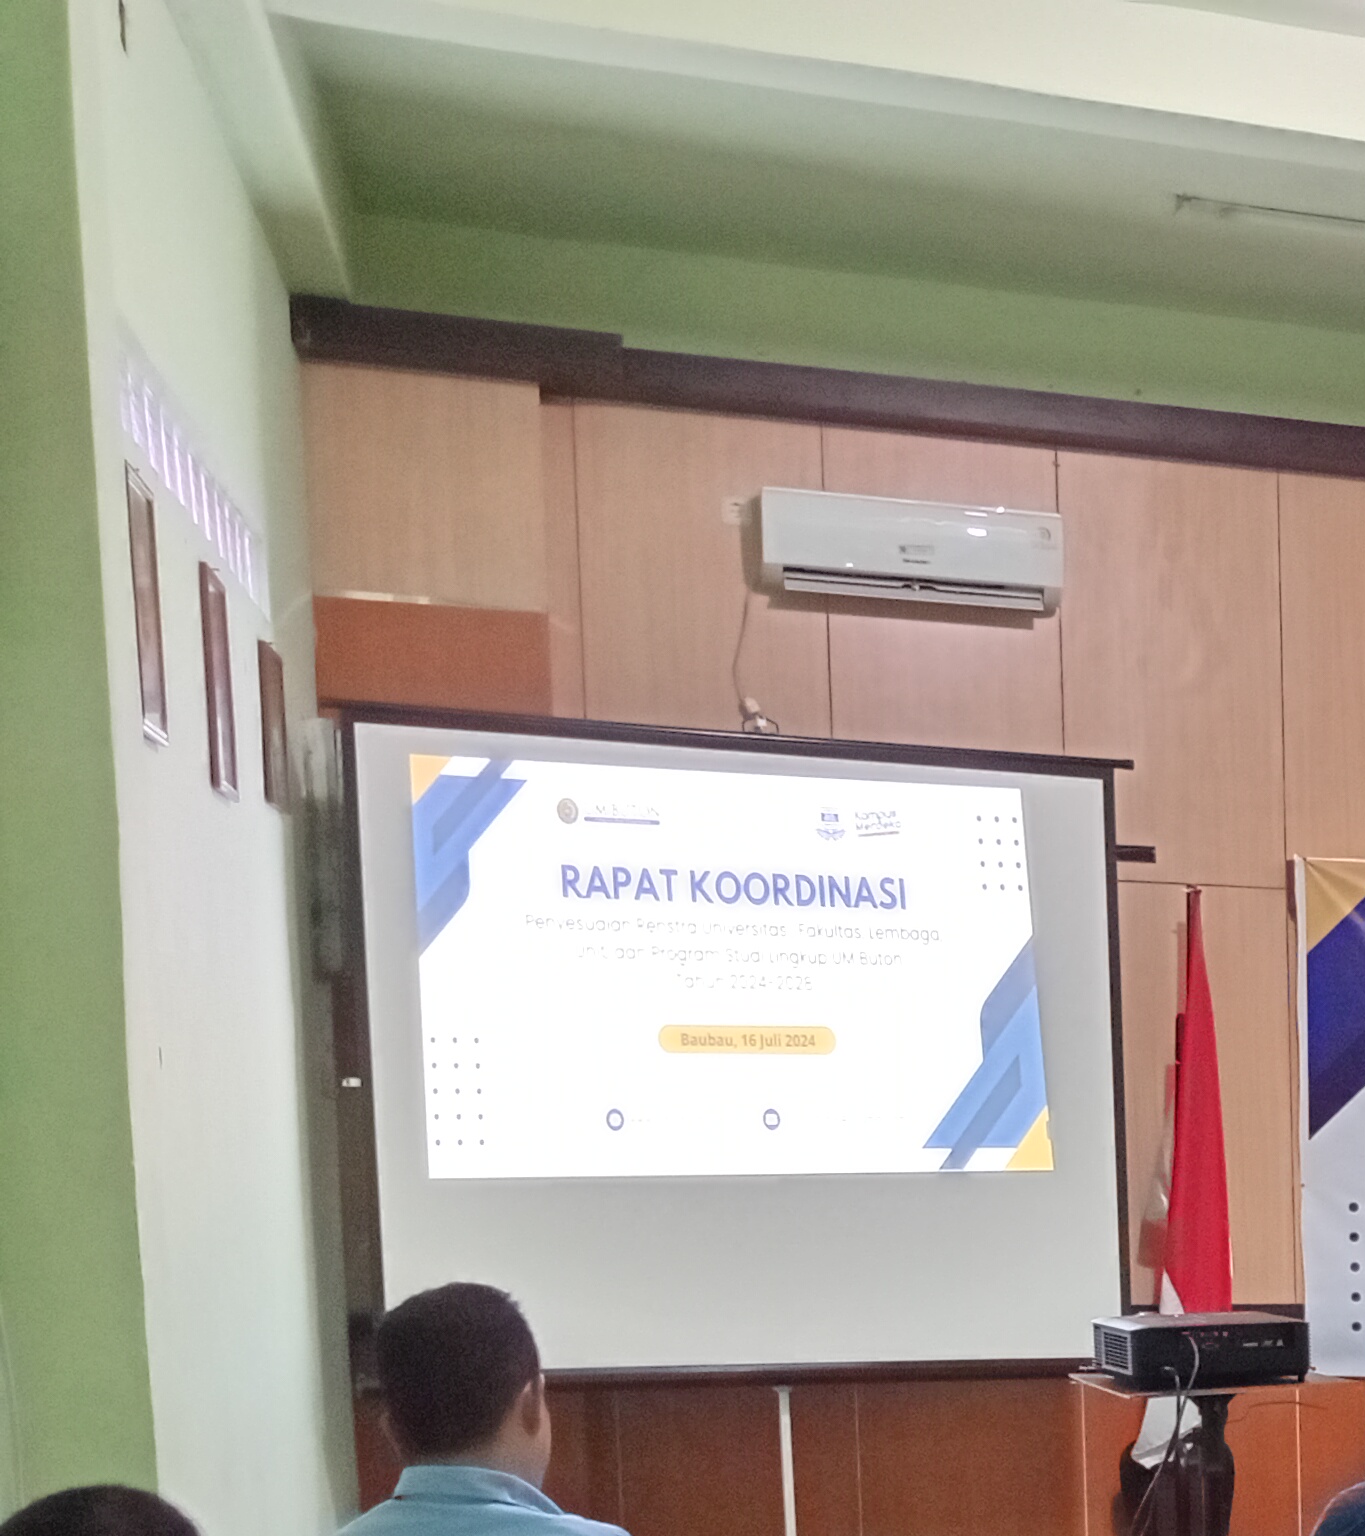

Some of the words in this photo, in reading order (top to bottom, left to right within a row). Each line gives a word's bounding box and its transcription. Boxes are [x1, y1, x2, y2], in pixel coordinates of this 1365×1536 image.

[561, 864, 678, 902] RAPAT
[690, 870, 906, 910] KOORDINASI
[680, 1032, 738, 1049] Baubau,
[741, 1033, 757, 1048] 16
[760, 1032, 781, 1051] Juli
[785, 1033, 816, 1048] 2024
